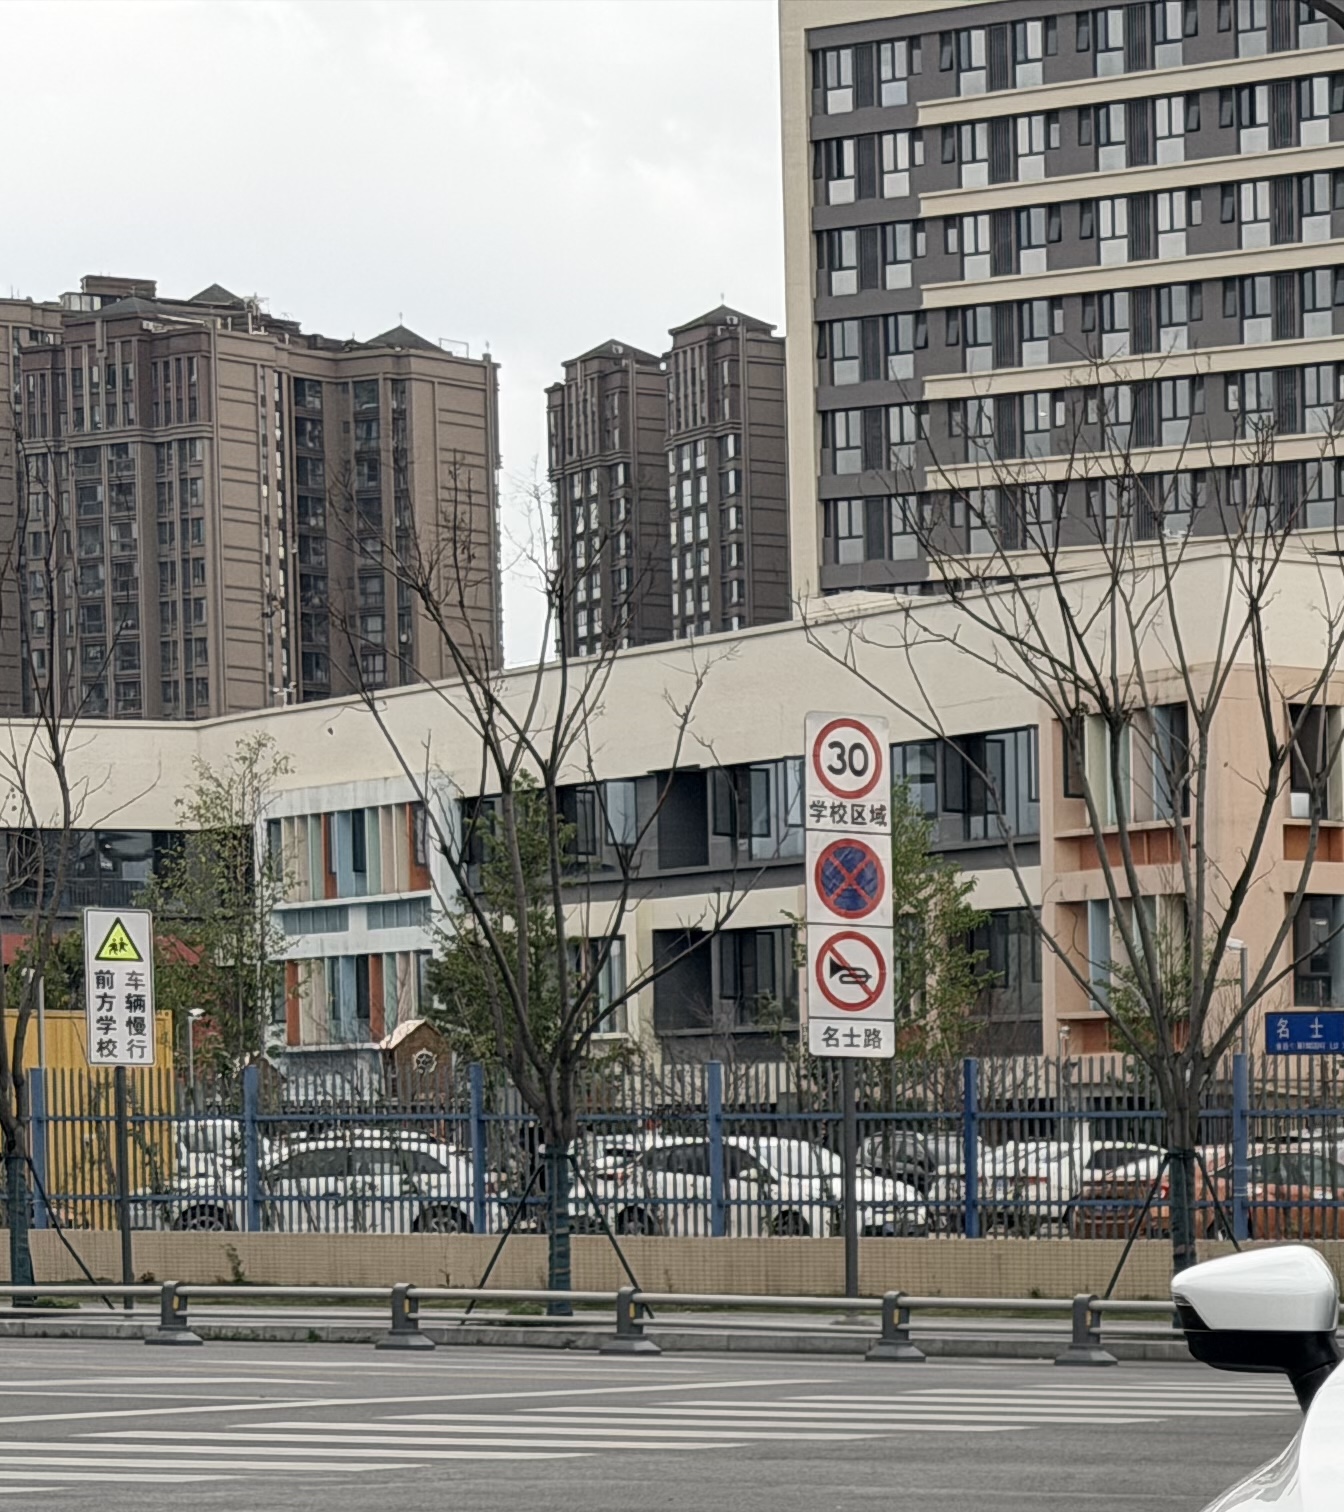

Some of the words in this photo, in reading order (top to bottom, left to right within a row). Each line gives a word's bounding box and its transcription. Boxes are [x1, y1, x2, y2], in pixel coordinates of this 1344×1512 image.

[827, 741, 869, 777] 30
[809, 800, 887, 827] 学校区域
[94, 969, 118, 1058] 前方学校
[125, 970, 147, 1058] 车辆慢行
[821, 1025, 883, 1049] 名士路
